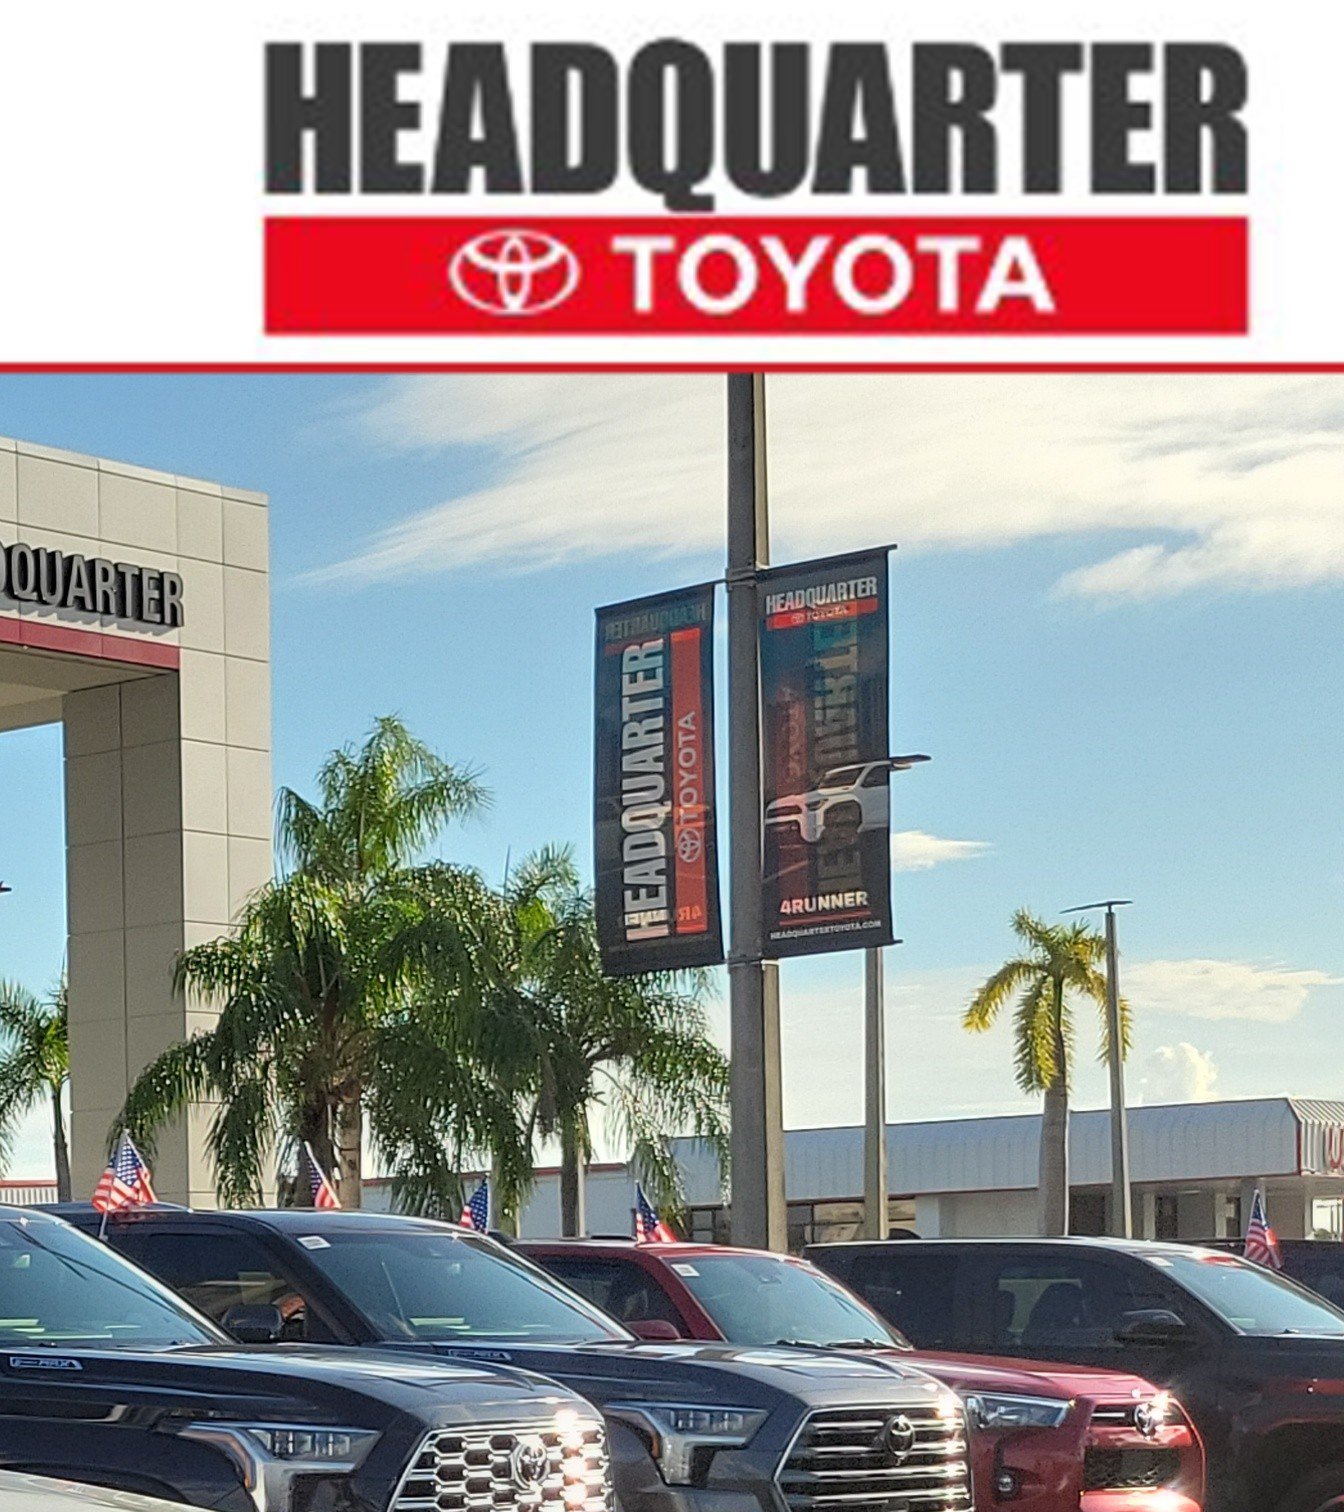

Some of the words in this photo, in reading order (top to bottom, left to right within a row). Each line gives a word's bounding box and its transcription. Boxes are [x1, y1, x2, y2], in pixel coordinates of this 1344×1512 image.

[765, 576, 878, 616] HEADQUARTER
[621, 638, 672, 941] HEADQUARTER
[677, 710, 699, 826] TOYOTA
[780, 891, 868, 915] 4RUNNER
